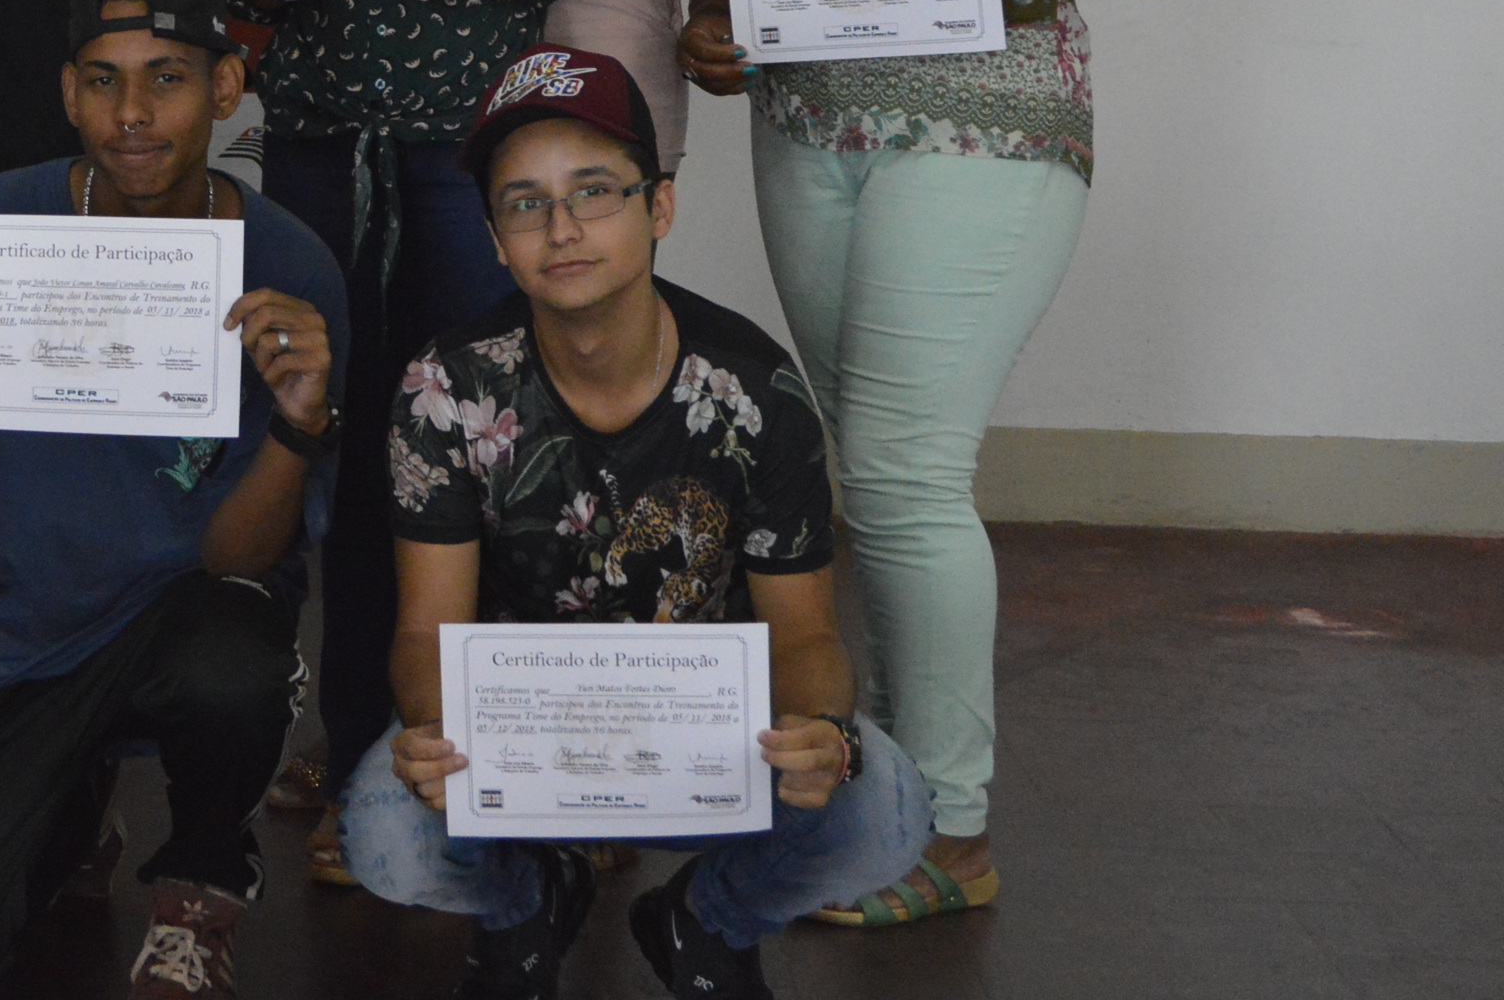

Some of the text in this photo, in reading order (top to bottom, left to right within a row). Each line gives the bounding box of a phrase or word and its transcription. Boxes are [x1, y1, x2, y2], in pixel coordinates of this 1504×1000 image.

[842, 24, 880, 33] CPER
[498, 52, 571, 98] NIKE
[542, 78, 584, 96] SB
[70, 244, 89, 259] de
[95, 244, 194, 266] Participação
[16, 278, 31, 288] que
[190, 281, 211, 290] R.G.
[54, 388, 97, 397] CPER
[492, 652, 719, 672] Certificado de Participação
